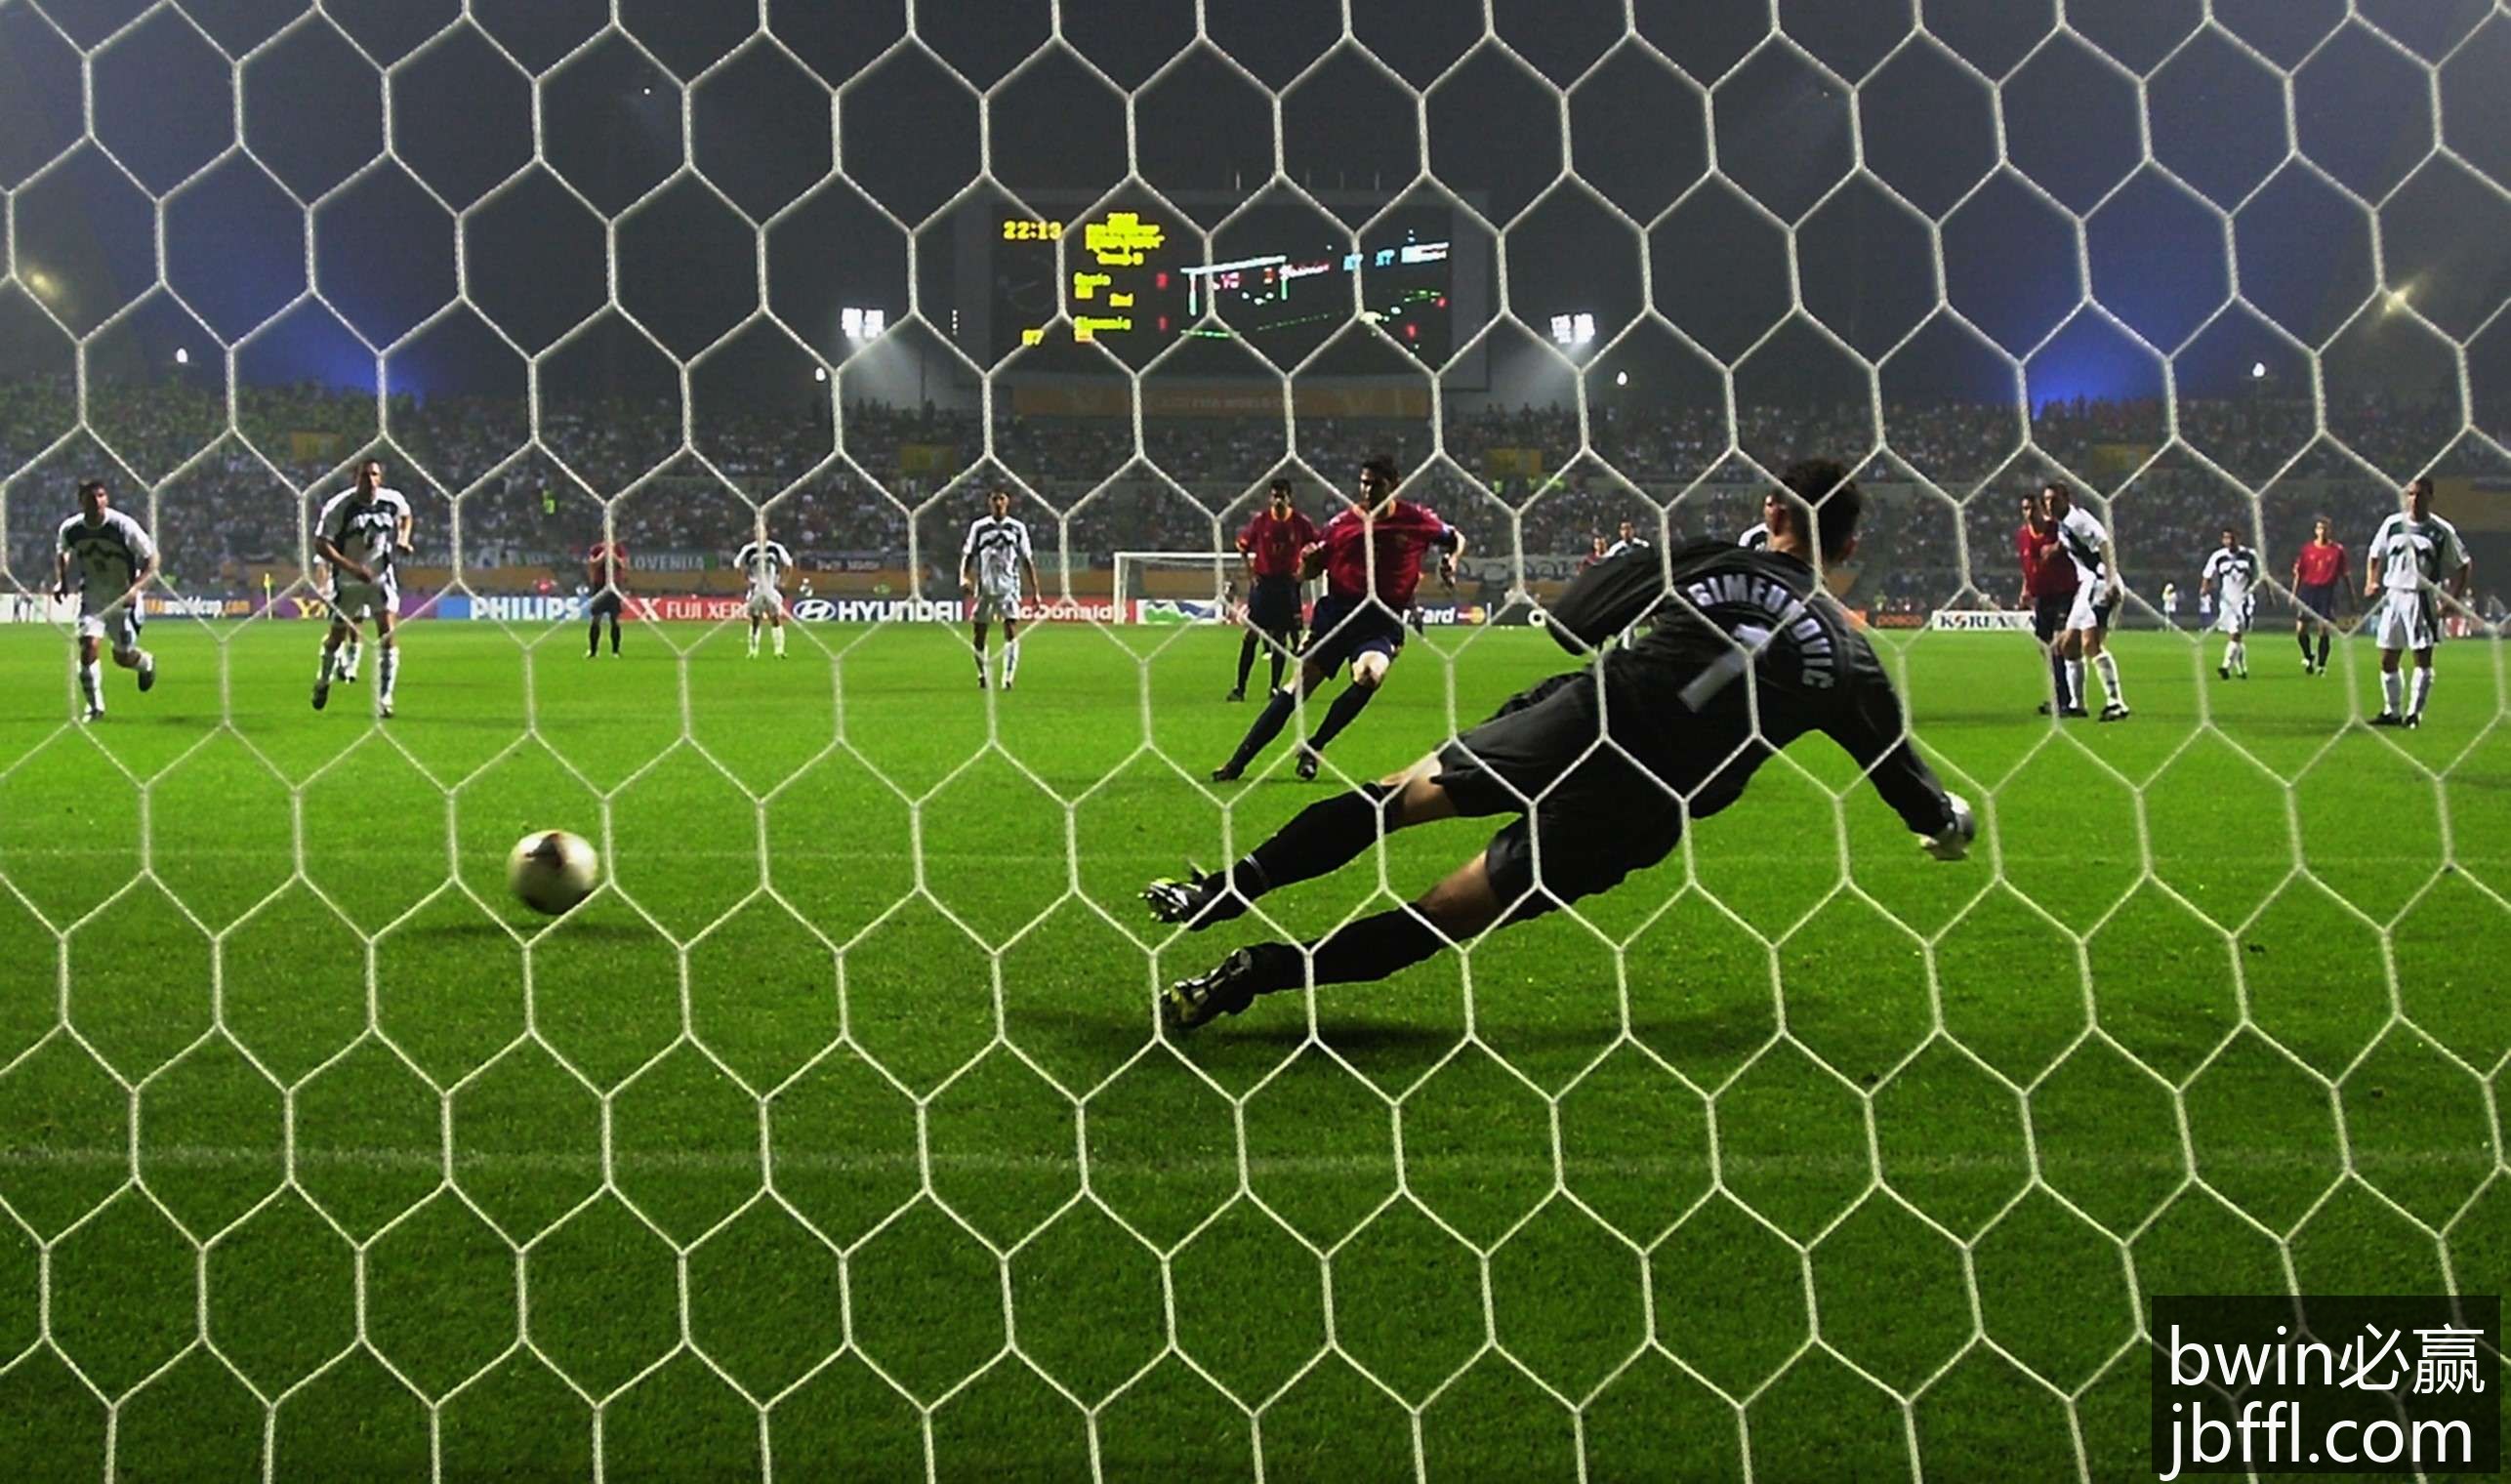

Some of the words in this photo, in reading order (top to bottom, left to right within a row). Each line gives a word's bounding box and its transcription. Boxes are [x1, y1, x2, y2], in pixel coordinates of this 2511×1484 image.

[624, 553, 705, 570] LOVENIJA
[470, 598, 581, 620] PHILIPS
[667, 601, 702, 618] FUJI
[707, 601, 768, 619] XER
[838, 600, 963, 622] HYUNDAI
[1020, 603, 1129, 620] cDonald
[1676, 623, 1771, 714] 1
